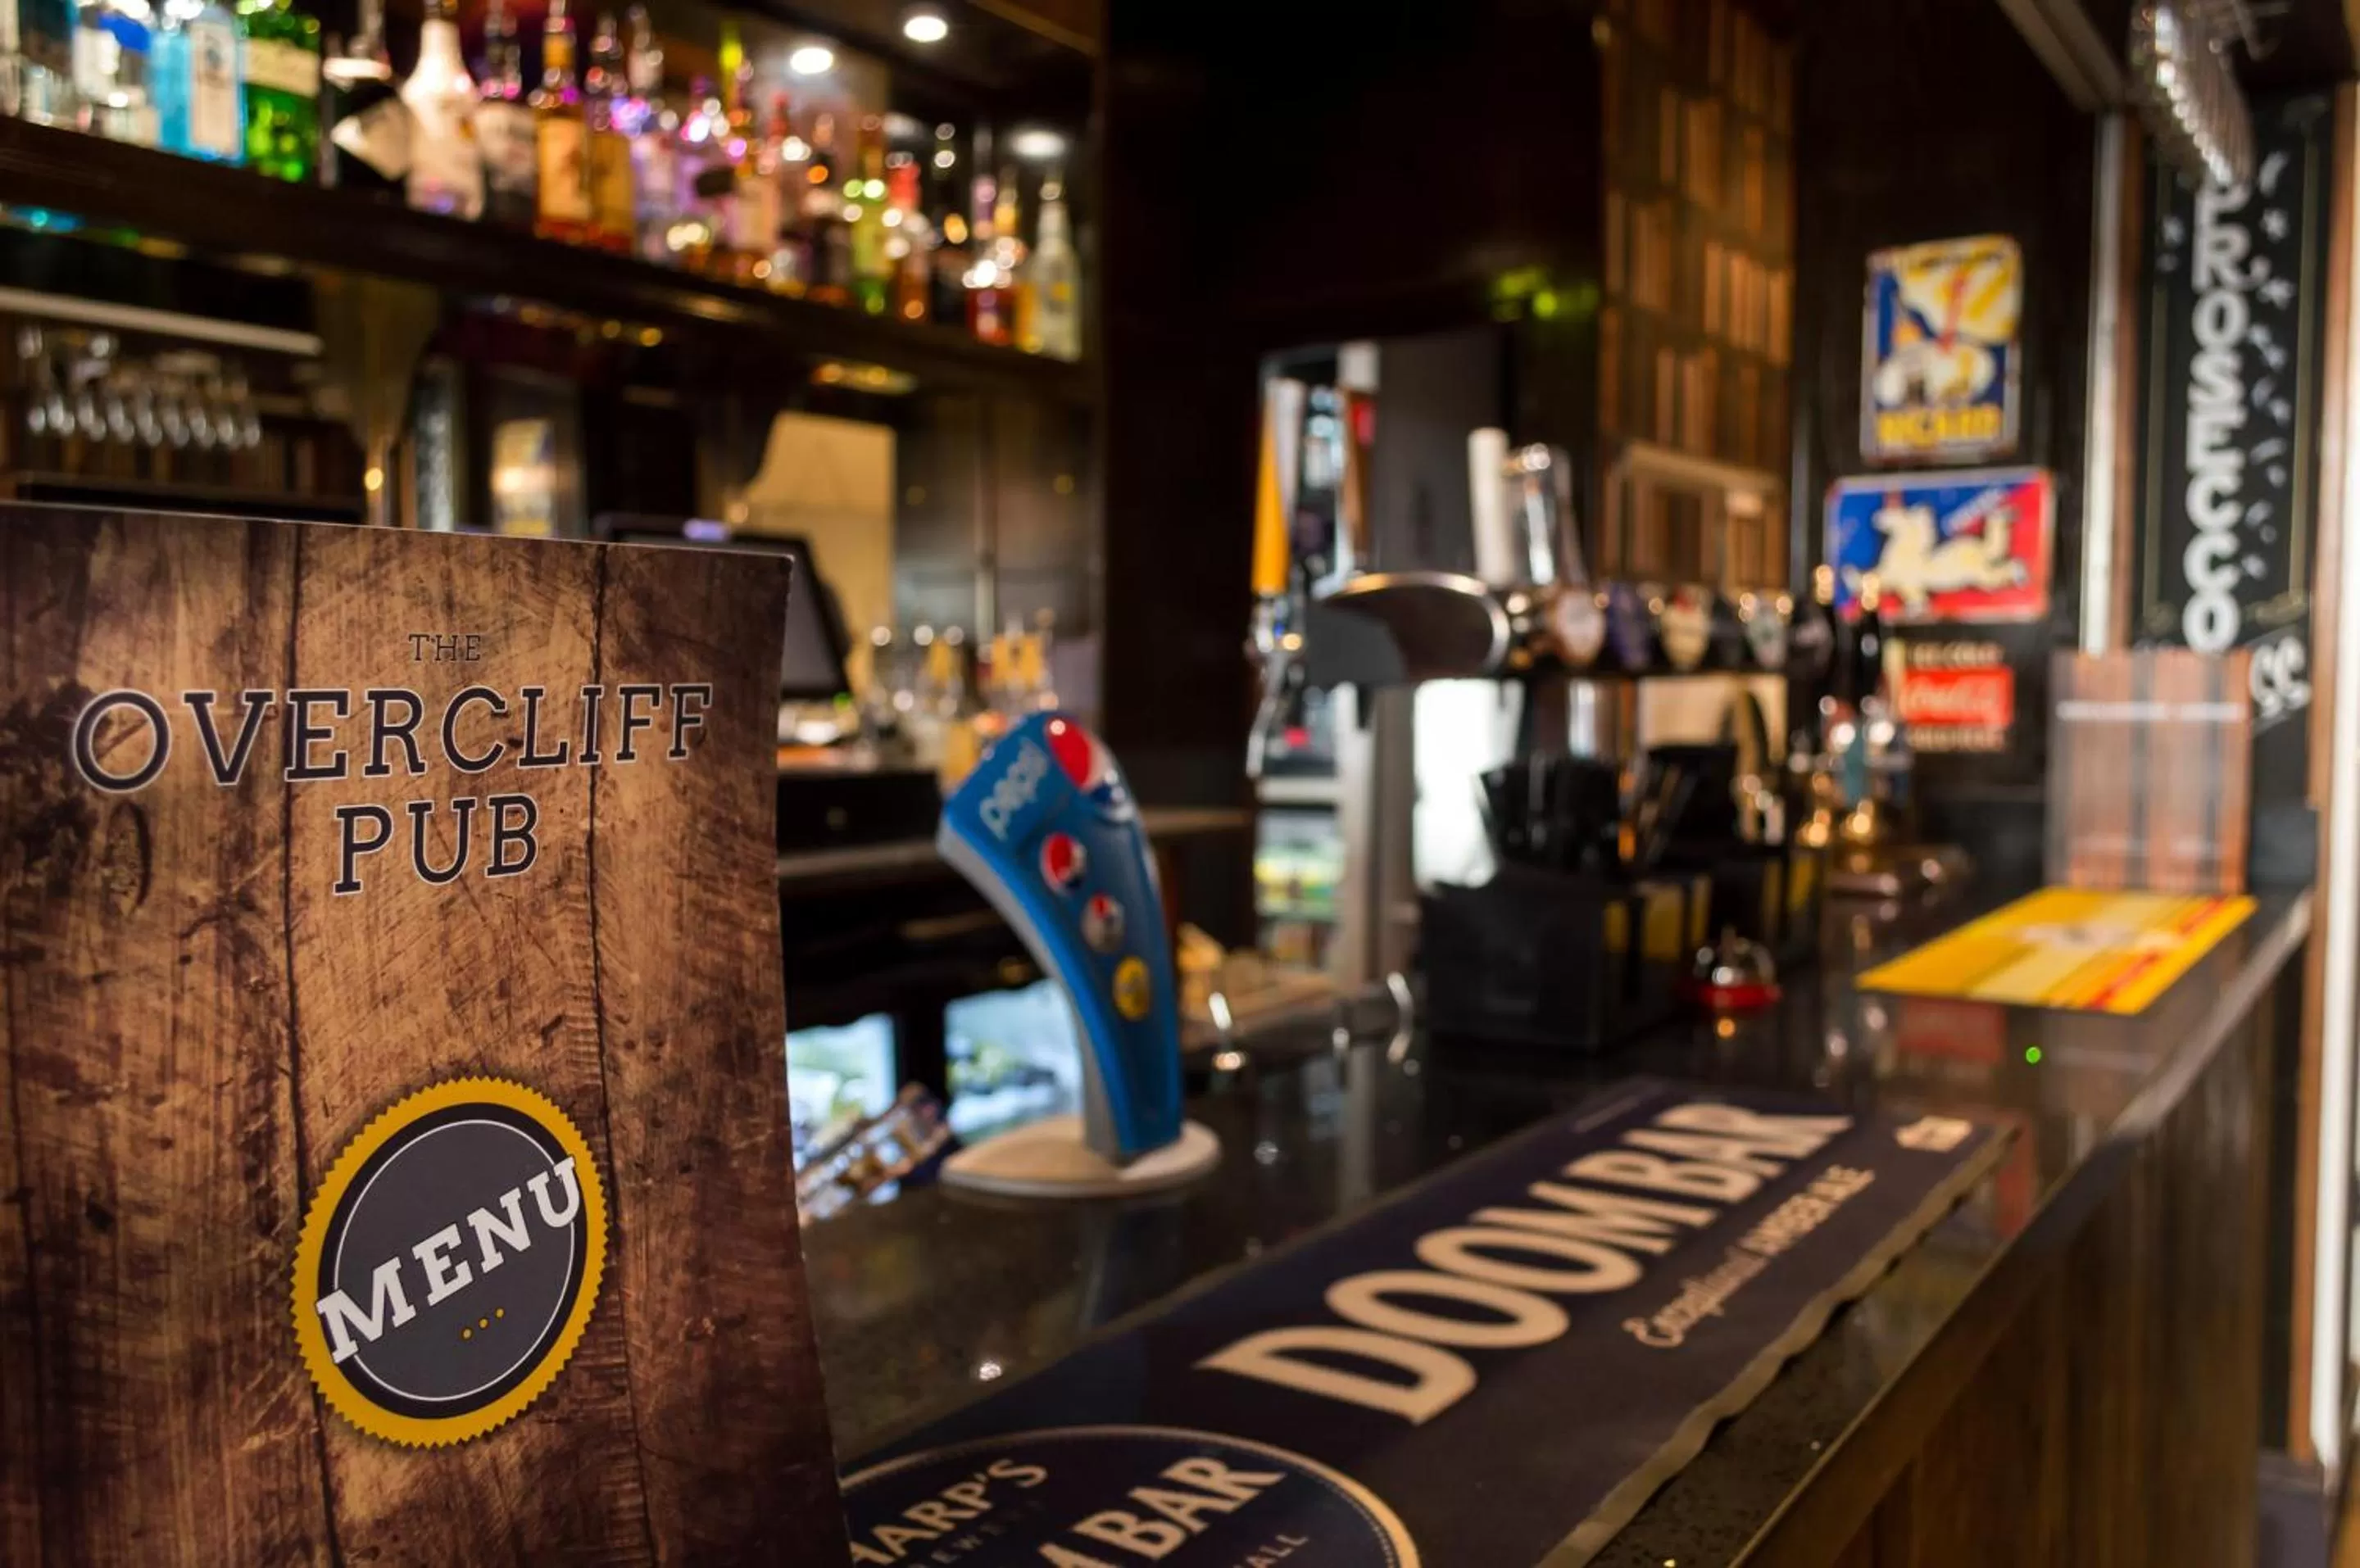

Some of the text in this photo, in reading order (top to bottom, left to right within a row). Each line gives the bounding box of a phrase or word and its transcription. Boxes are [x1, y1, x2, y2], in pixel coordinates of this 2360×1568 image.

[408, 633, 481, 661] THE
[71, 682, 713, 794] OVERCLIFF
[332, 793, 540, 895] PUB
[315, 1156, 581, 1364] MENU
[1193, 1102, 1855, 1426] DOOM BAR
[849, 1458, 1049, 1566] HARP'S
[1071, 1457, 1288, 1560] BAR
